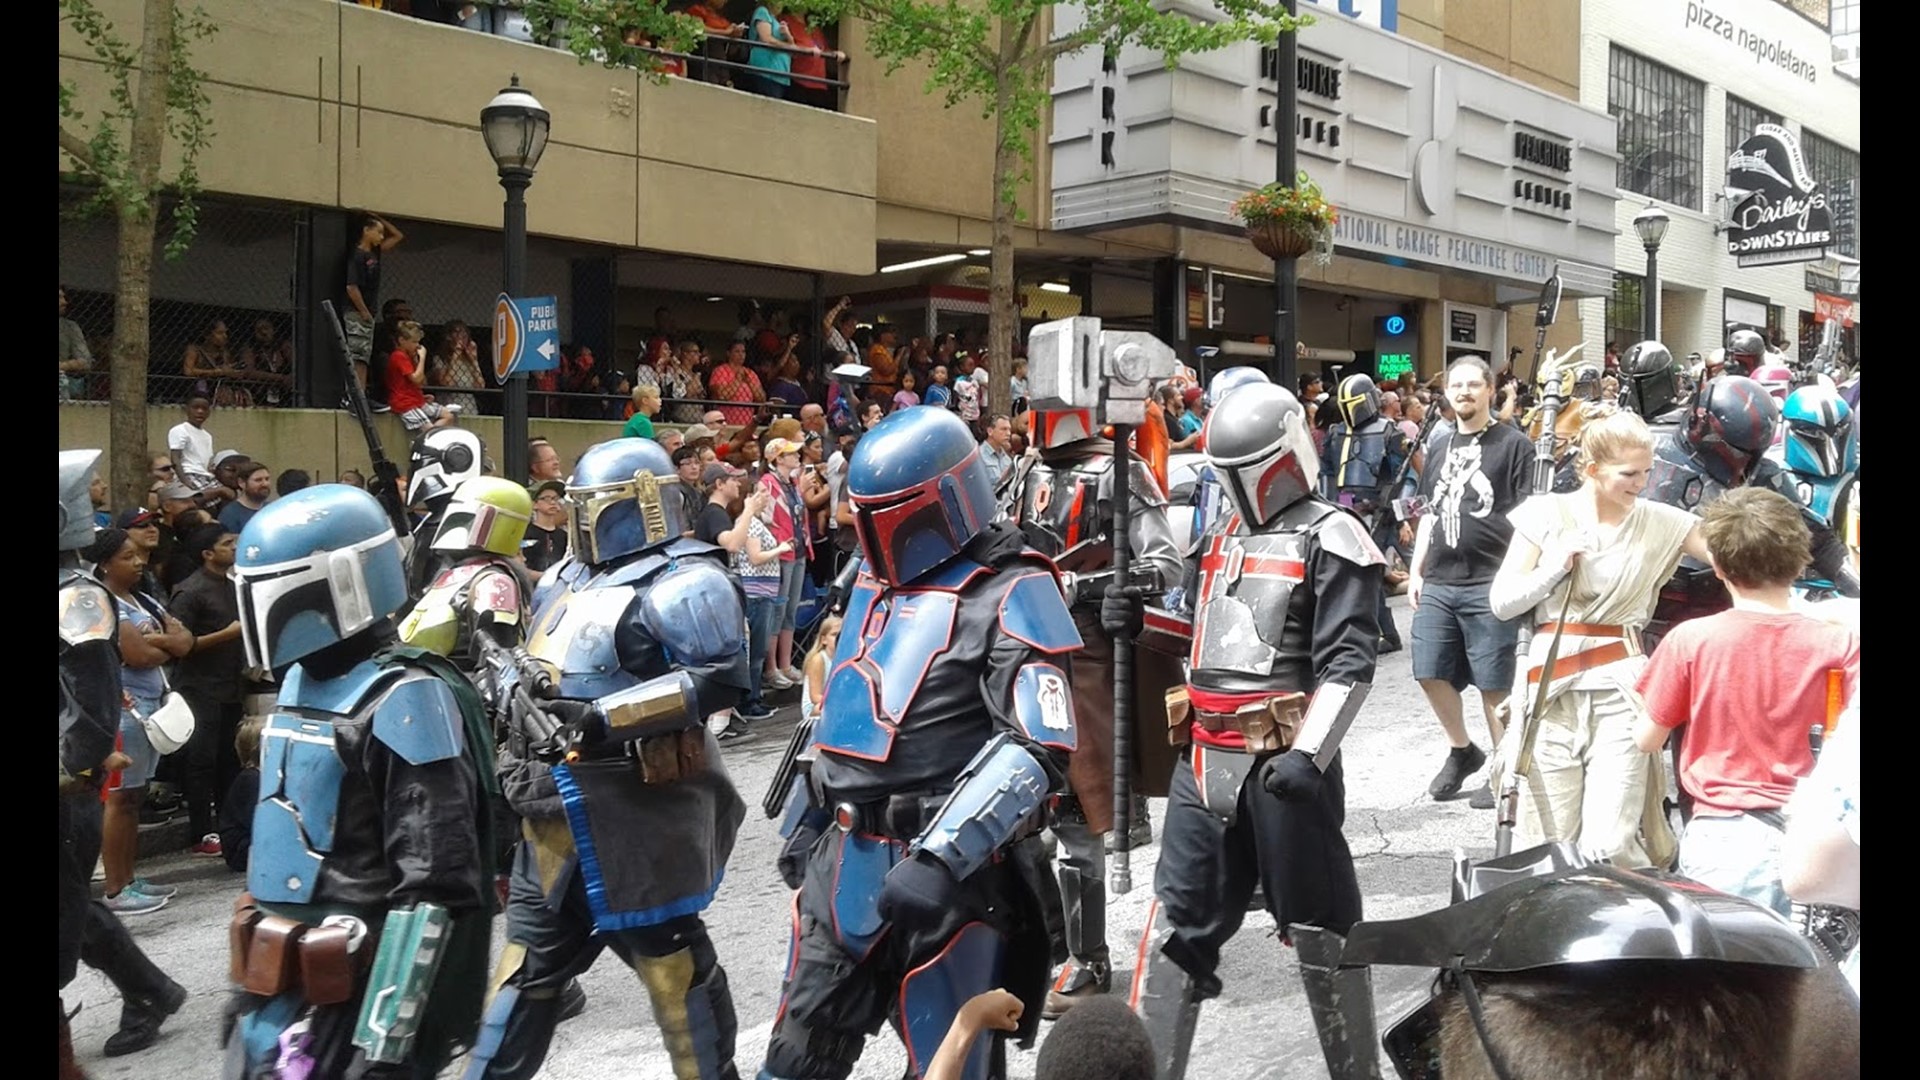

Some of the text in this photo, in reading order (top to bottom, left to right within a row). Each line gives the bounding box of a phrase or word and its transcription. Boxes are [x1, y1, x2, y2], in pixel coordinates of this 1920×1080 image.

[1685, 0, 1816, 83] pizza napoletana
[1261, 46, 1341, 100] PHTREE
[1261, 105, 1340, 147] CTER
[1515, 131, 1572, 172] PEACHTREE
[1514, 180, 1571, 210] CENTER
[1335, 215, 1547, 278] ATIONAL GARAGE PEACHTREE CENTER
[1729, 230, 1831, 252] DOWNSTAIRS
[1379, 363, 1413, 374] PARKING
[1381, 354, 1411, 364] PUBLIC
